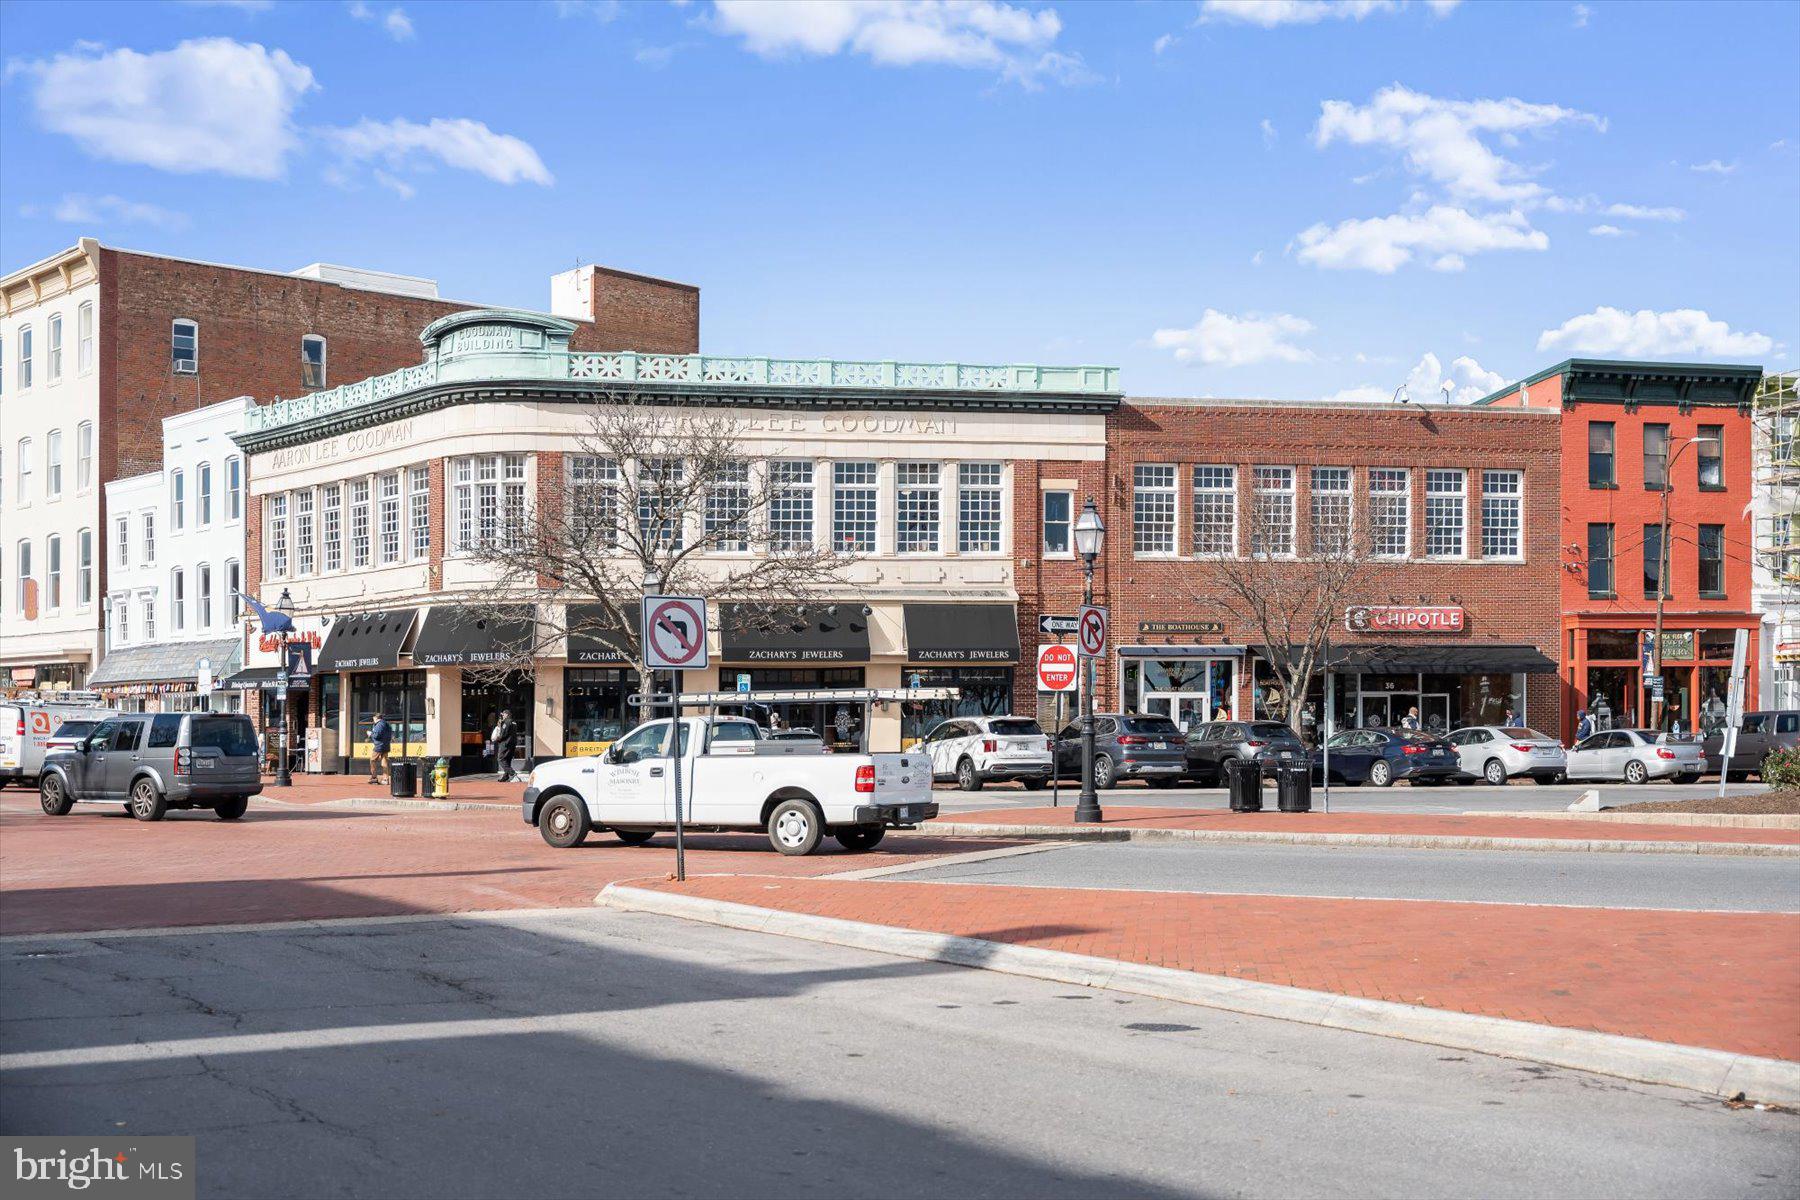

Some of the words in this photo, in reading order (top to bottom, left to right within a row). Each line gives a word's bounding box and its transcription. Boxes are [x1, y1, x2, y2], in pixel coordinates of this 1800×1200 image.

[457, 339, 513, 351] BUILDING
[748, 413, 806, 432] LEE
[272, 446, 311, 470] AARON
[315, 439, 339, 461] LEE
[1375, 612, 1460, 627] CHIPOTLE
[425, 653, 464, 663] ZACHARY'S
[470, 652, 511, 662] JEWELERS
[749, 650, 797, 659] ZACHARY'S
[801, 650, 844, 660] JEWELERS
[918, 650, 965, 659] ZACHARY'S
[969, 650, 1010, 659] JEWELERS
[1057, 653, 1072, 661] NOT
[335, 659, 358, 668] ZACHARY'S
[358, 657, 379, 667] JEWELERS
[1046, 674, 1068, 682] ENTER
[1385, 682, 1395, 690] 36
